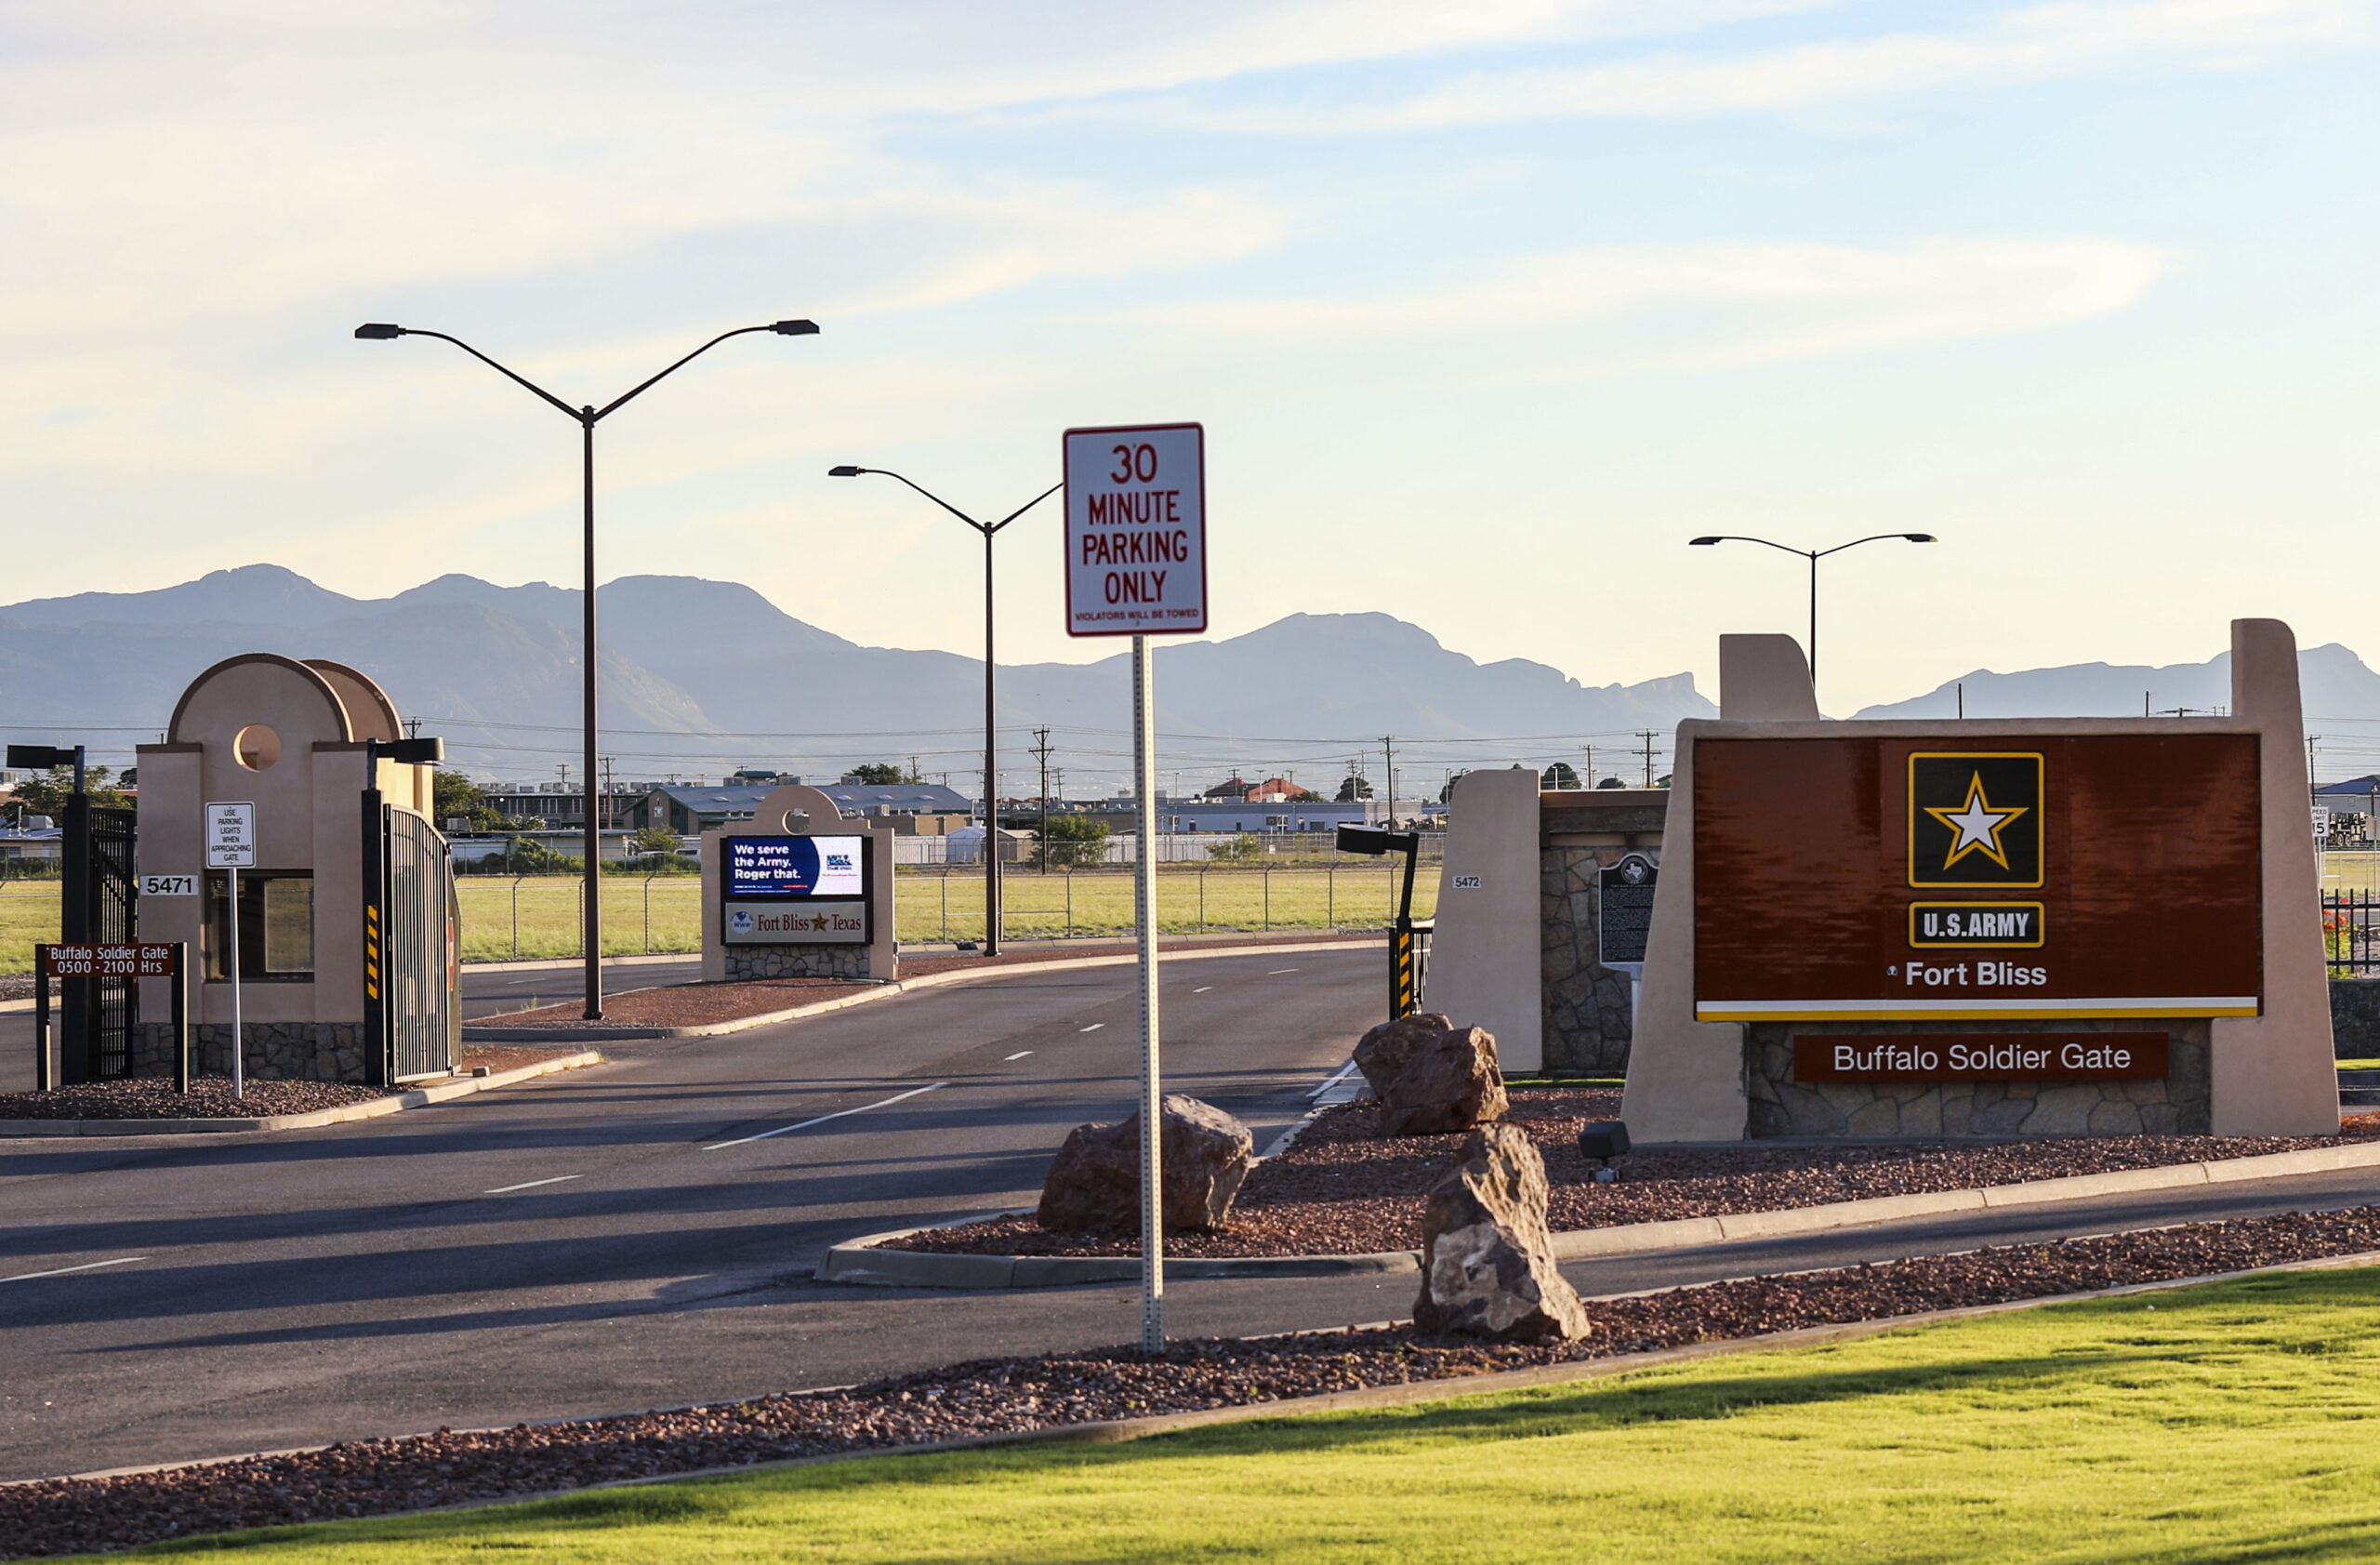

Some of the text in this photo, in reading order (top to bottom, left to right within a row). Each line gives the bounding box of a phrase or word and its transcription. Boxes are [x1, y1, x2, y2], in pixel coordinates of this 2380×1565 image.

[1110, 443, 1157, 484] 30
[1089, 490, 1181, 525] MINUTE
[1083, 530, 1188, 565] PARKING
[1104, 570, 1167, 604] ONLY
[1075, 608, 1199, 621] VIOLATORS WILL BE TOWED
[218, 817, 243, 826] PARKING
[222, 835, 240, 843] WHEN
[211, 844, 251, 853] APPROACHING
[734, 844, 789, 855] We serve
[734, 856, 792, 869] the Army.
[734, 869, 801, 881] Roger that.
[1455, 877, 1480, 887] 5472
[147, 878, 192, 894] 5471
[758, 913, 862, 931] Fort Bliss Texas
[50, 946, 168, 961] Buffalo Soldier Gate
[141, 961, 163, 974] Hrs
[1906, 962, 2047, 986] Fort Bliss
[1833, 1042, 2131, 1072] Buffalo Soldier Gate
